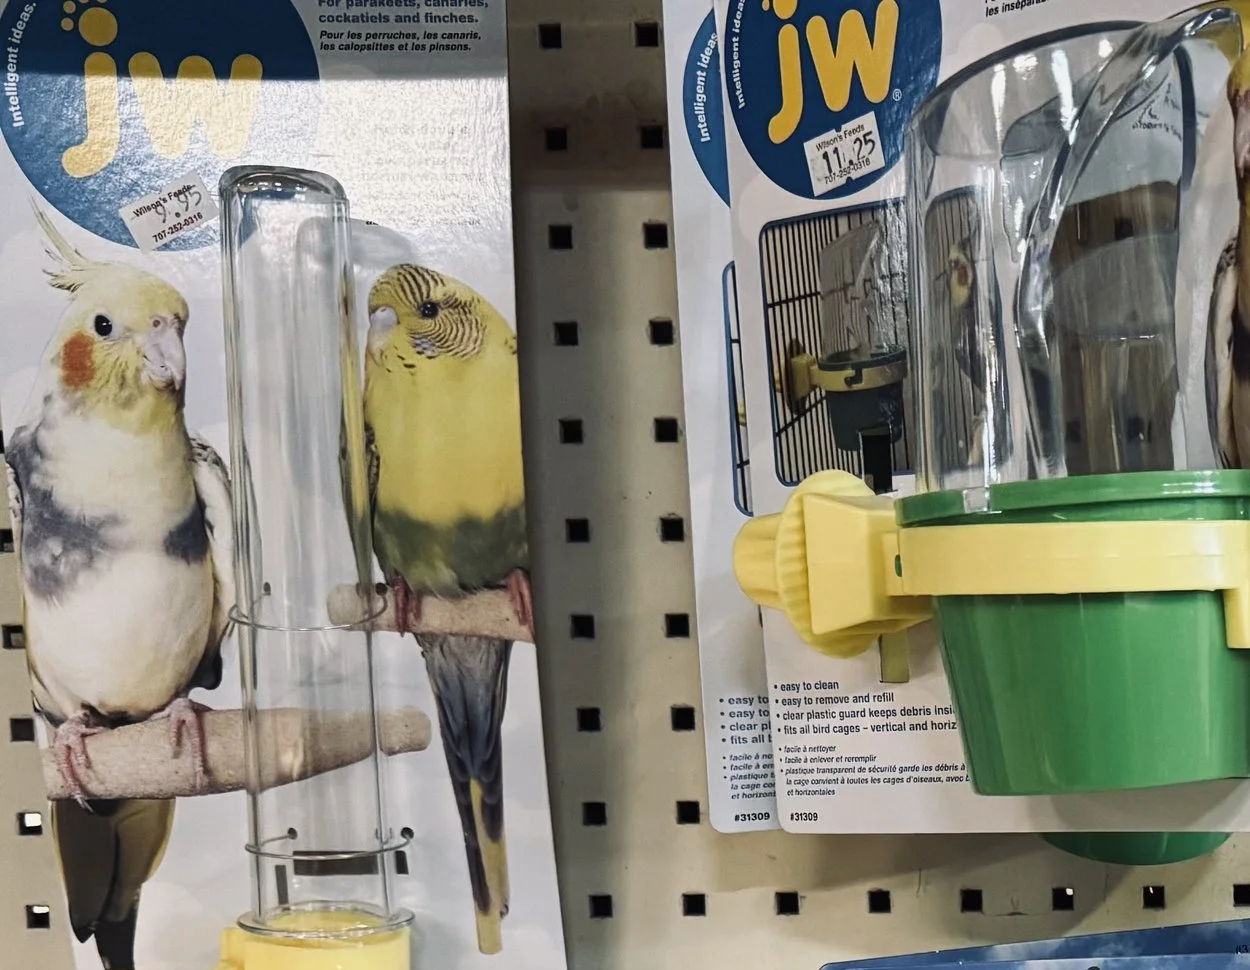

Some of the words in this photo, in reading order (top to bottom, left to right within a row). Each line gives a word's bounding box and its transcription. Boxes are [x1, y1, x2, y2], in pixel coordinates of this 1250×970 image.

[8, 2, 36, 44] ideas.
[319, 12, 390, 23] cockatiels
[394, 12, 420, 23] and
[424, 12, 479, 23] finches.
[320, 31, 343, 39] Pour
[365, 31, 420, 41] perruches,
[441, 31, 481, 40] canaris,
[429, 43, 471, 52] pinsons.
[732, 35, 744, 109] Intelligent
[768, 0, 899, 144] jw
[4, 47, 24, 127] Intelligent
[62, 7, 263, 178] jw
[694, 68, 710, 143] Intelligent
[823, 131, 875, 173] 11.25
[152, 211, 204, 242] 707-252-0316
[780, 683, 800, 693] easy
[803, 682, 812, 690] to
[814, 680, 839, 689] clean
[781, 697, 801, 707] easy
[804, 696, 813, 705] to
[816, 695, 849, 704] remove
[853, 693, 870, 703] and
[873, 692, 894, 702] refill
[783, 711, 804, 720] clear
[807, 709, 836, 722] plastic
[839, 708, 866, 720] guard
[869, 708, 897, 719] keeps
[900, 706, 932, 716] debris
[784, 725, 797, 734] fits
[800, 724, 810, 734] all
[813, 724, 830, 733] bird
[833, 725, 860, 735] cages
[871, 722, 906, 732] vertical
[909, 721, 928, 731] and
[735, 812, 770, 821] #31309
[790, 812, 818, 821] #31309
